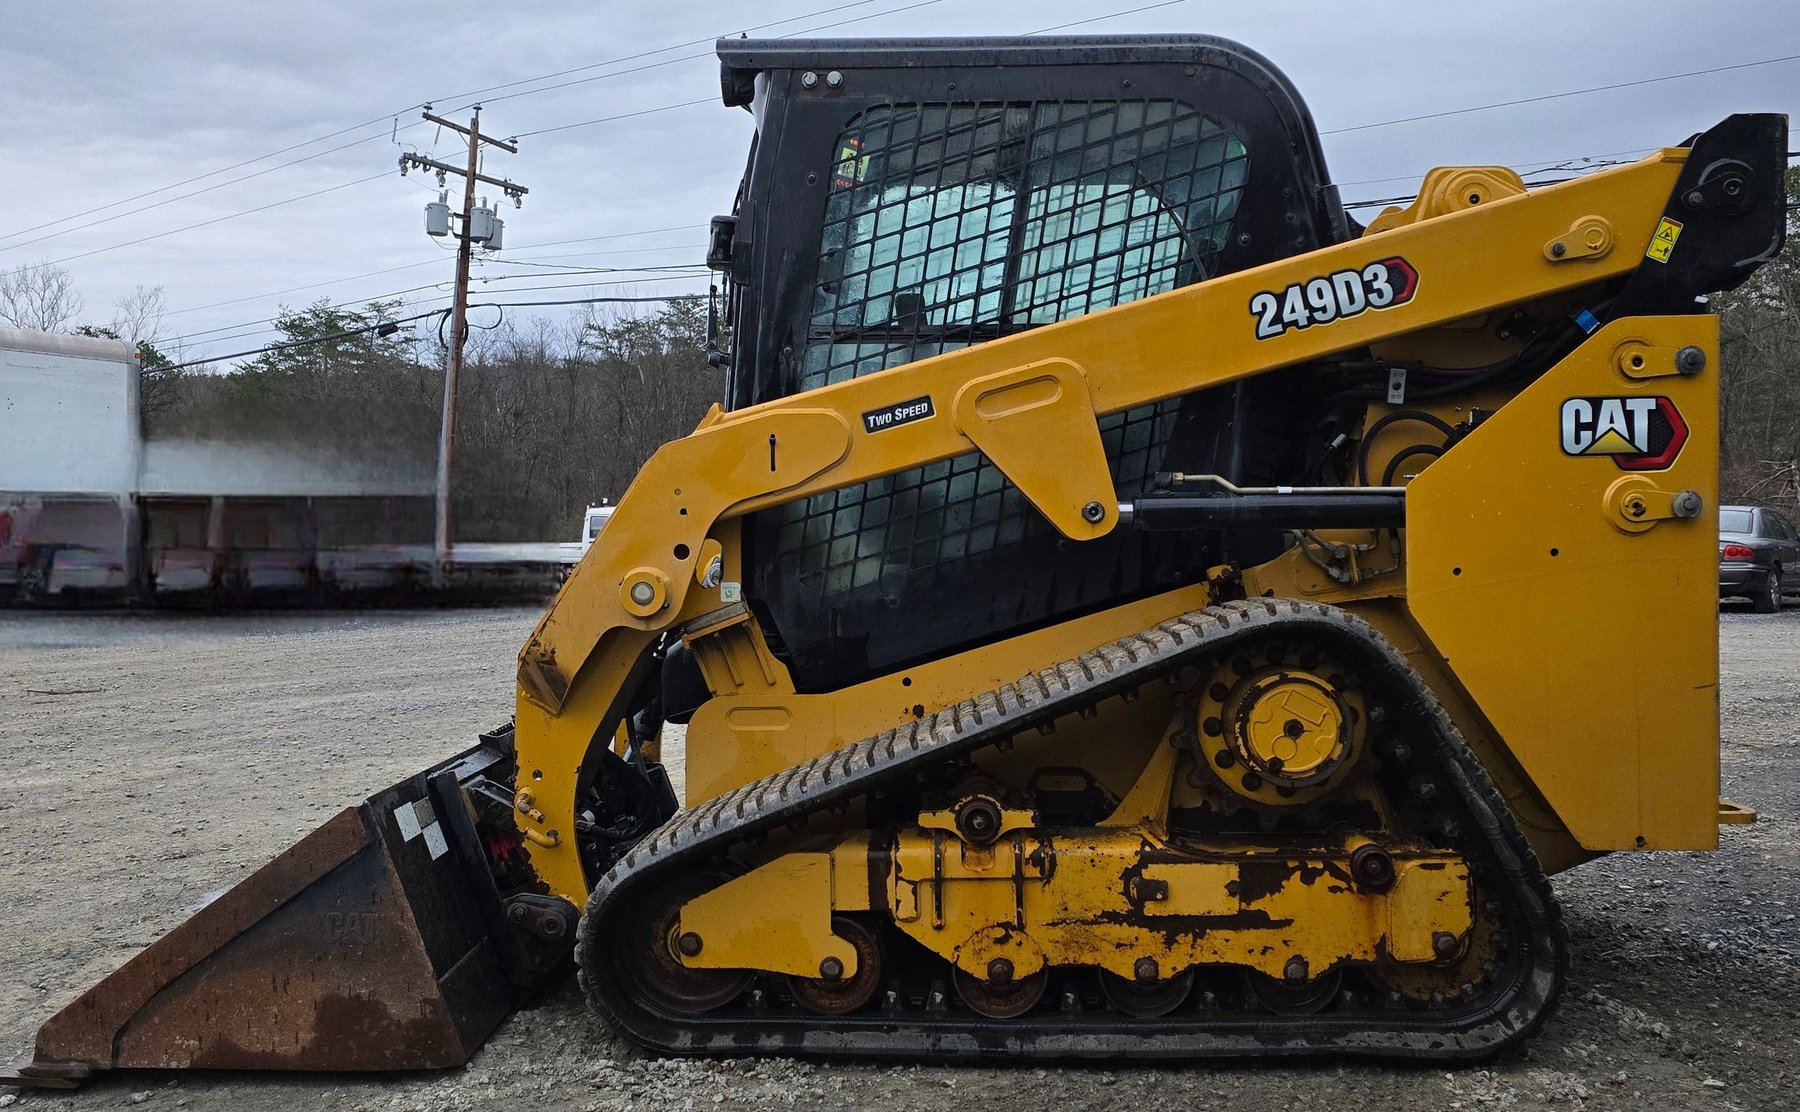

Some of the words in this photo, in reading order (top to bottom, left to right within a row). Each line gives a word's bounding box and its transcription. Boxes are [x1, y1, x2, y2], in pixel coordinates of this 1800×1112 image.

[1251, 263, 1394, 338] 249D3
[868, 412, 892, 428] TWO
[894, 402, 928, 421] SPEED
[1562, 398, 1656, 454] CAT
